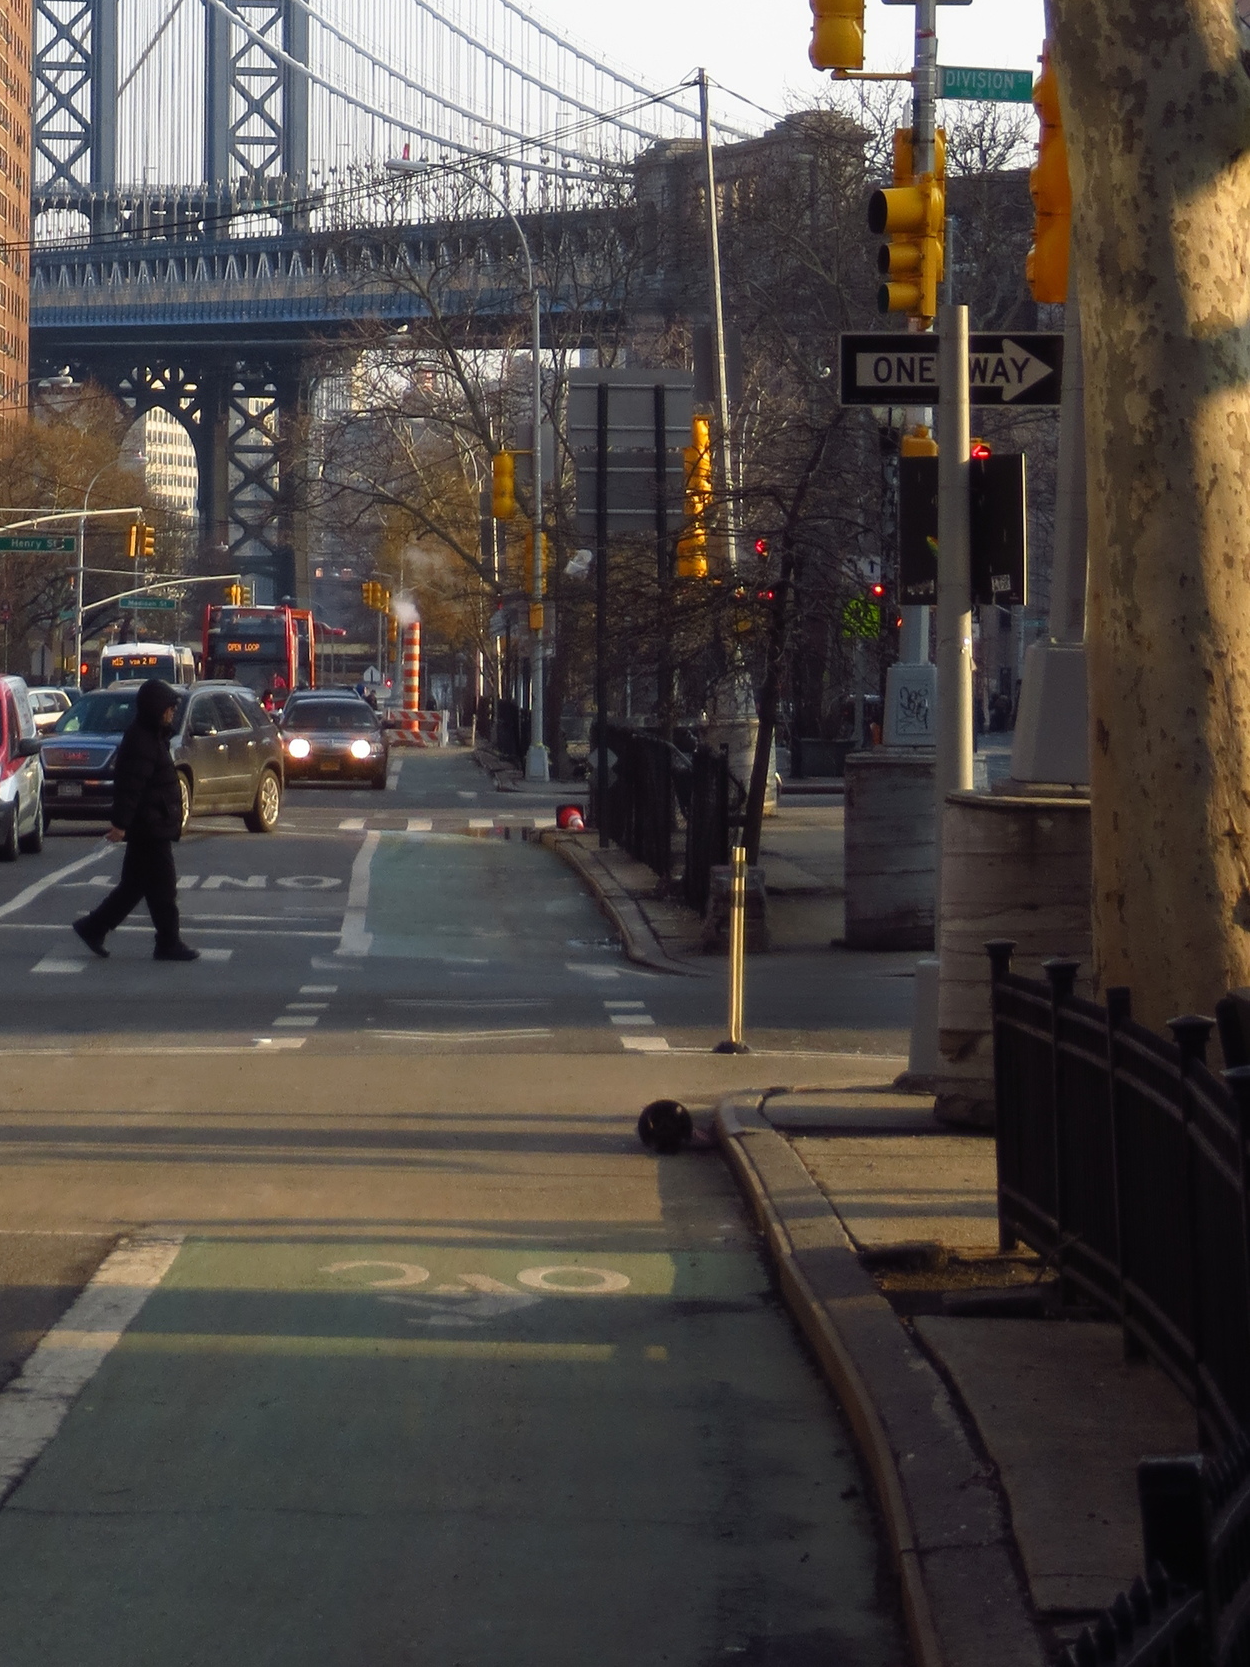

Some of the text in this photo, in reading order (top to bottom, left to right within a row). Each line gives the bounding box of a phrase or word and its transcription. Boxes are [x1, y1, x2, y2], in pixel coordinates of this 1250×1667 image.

[945, 70, 1028, 89] DIVISION ST
[873, 356, 1031, 384] ONE WAY
[11, 535, 41, 551] Henry
[227, 642, 261, 652] OPEN LOOP
[142, 656, 147, 666] 2
